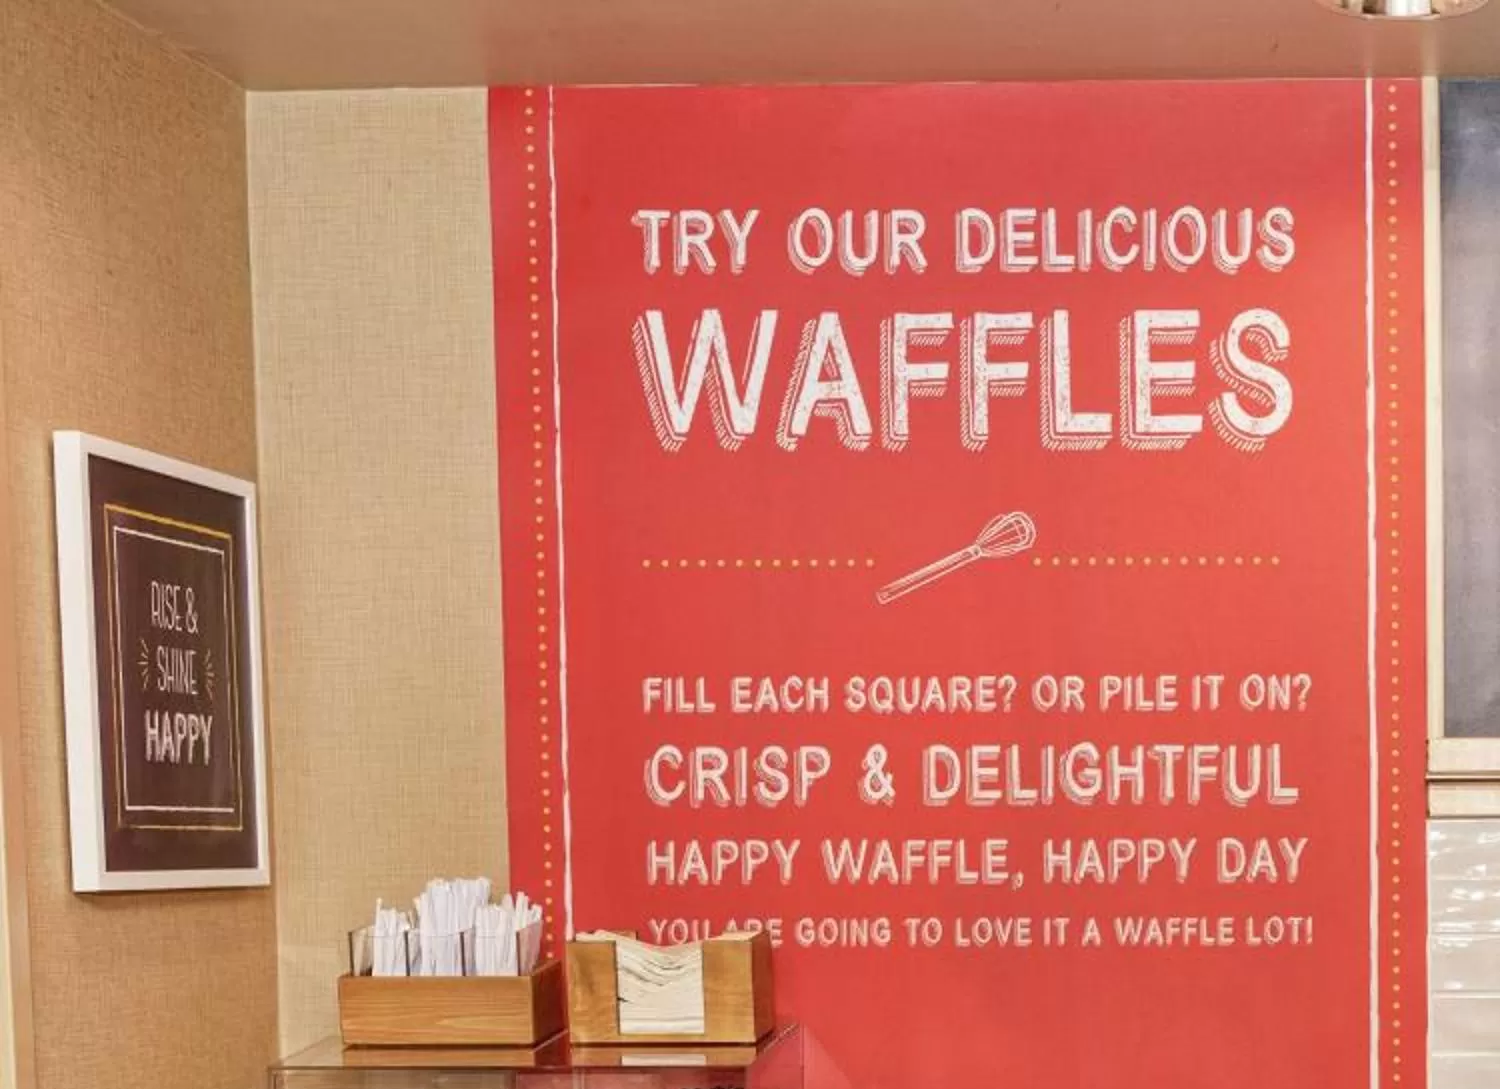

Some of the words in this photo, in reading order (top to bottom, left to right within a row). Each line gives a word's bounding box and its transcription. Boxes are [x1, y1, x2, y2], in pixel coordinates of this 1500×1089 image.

[631, 208, 760, 275] TRY
[787, 207, 928, 276] OUR
[955, 205, 1296, 274] DELICIOUS
[632, 308, 1294, 452] WAFFLES
[150, 581, 183, 631] RISE
[185, 588, 199, 636] &
[155, 646, 198, 696] SHINE
[643, 676, 716, 713] FILL
[730, 675, 830, 713] EACH
[845, 674, 1017, 713] SQUARE?
[1031, 674, 1086, 712] OR
[1098, 674, 1178, 711] PILE
[1192, 674, 1224, 711] IT
[1239, 673, 1312, 711] ON?
[144, 709, 214, 766] HAPPY
[644, 744, 832, 808] CRISP
[859, 744, 895, 806] &
[922, 742, 1299, 808] DELIGHTFUL
[646, 839, 800, 885] HAPPY
[821, 838, 1024, 889] WAFFLE,
[1042, 838, 1197, 884] HAPPY
[1216, 837, 1308, 883] DAY
[648, 918, 710, 944] YOU
[794, 917, 892, 947] GOING
[905, 917, 943, 945] TO
[954, 917, 1033, 947] LOVE
[1043, 917, 1070, 944] IT
[1080, 917, 1101, 945] A
[1114, 917, 1235, 946] WAFFLE
[1246, 915, 1313, 945] LOT!
